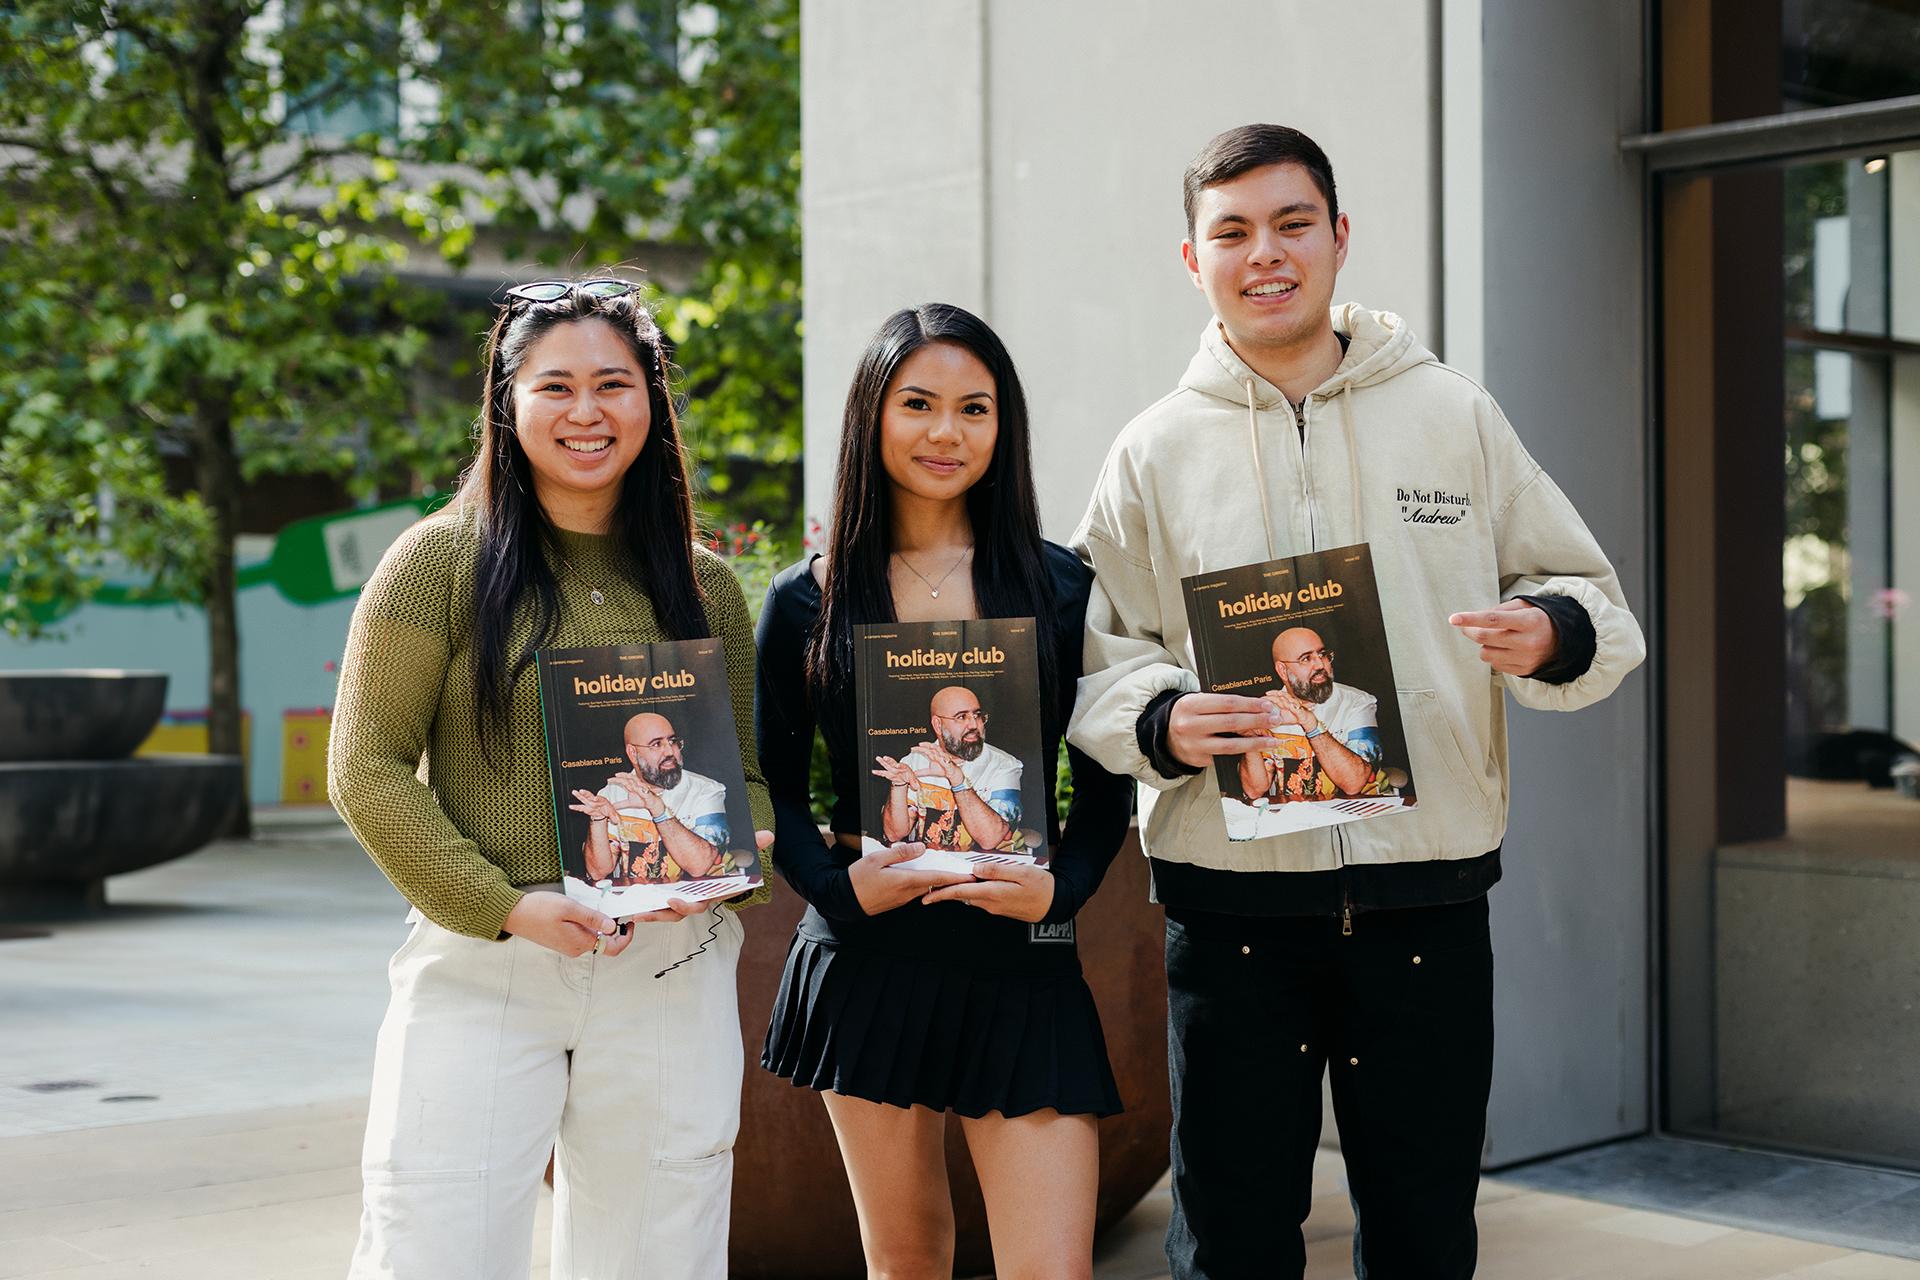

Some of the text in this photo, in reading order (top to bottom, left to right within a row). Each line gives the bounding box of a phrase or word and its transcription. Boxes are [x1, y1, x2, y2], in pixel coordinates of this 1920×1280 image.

[1397, 488, 1410, 502] Do
[1412, 490, 1431, 503] Not
[1218, 591, 1293, 618] holiday
[1297, 579, 1343, 604] club
[887, 647, 1005, 669] holiday club
[574, 670, 696, 695] holiday club
[1211, 675, 1273, 692] Casablanca Paris
[868, 726, 928, 736] Casablanca Paris
[561, 756, 623, 769] Casablanca Paris
